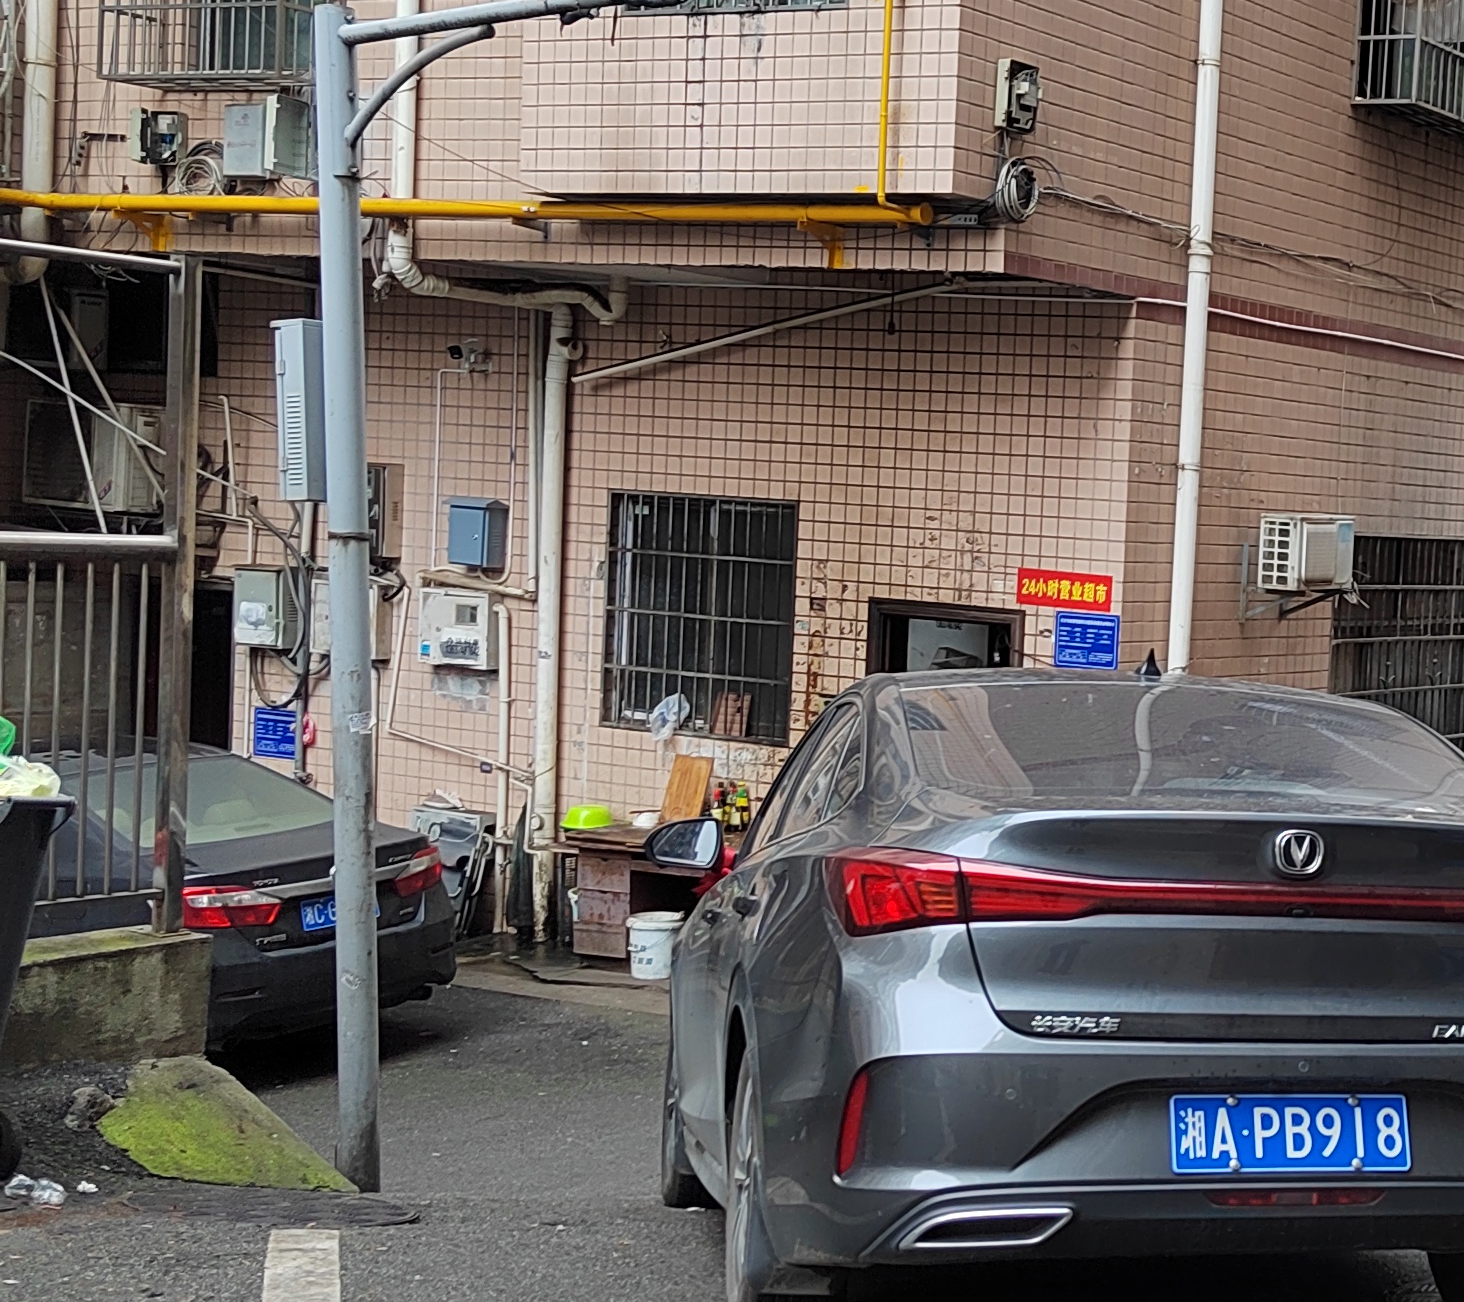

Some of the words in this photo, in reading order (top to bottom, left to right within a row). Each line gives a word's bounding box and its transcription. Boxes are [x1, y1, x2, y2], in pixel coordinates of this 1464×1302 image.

[1021, 577, 1108, 604] 24小时营业超市
[1031, 1015, 1121, 1033] 长安汽车
